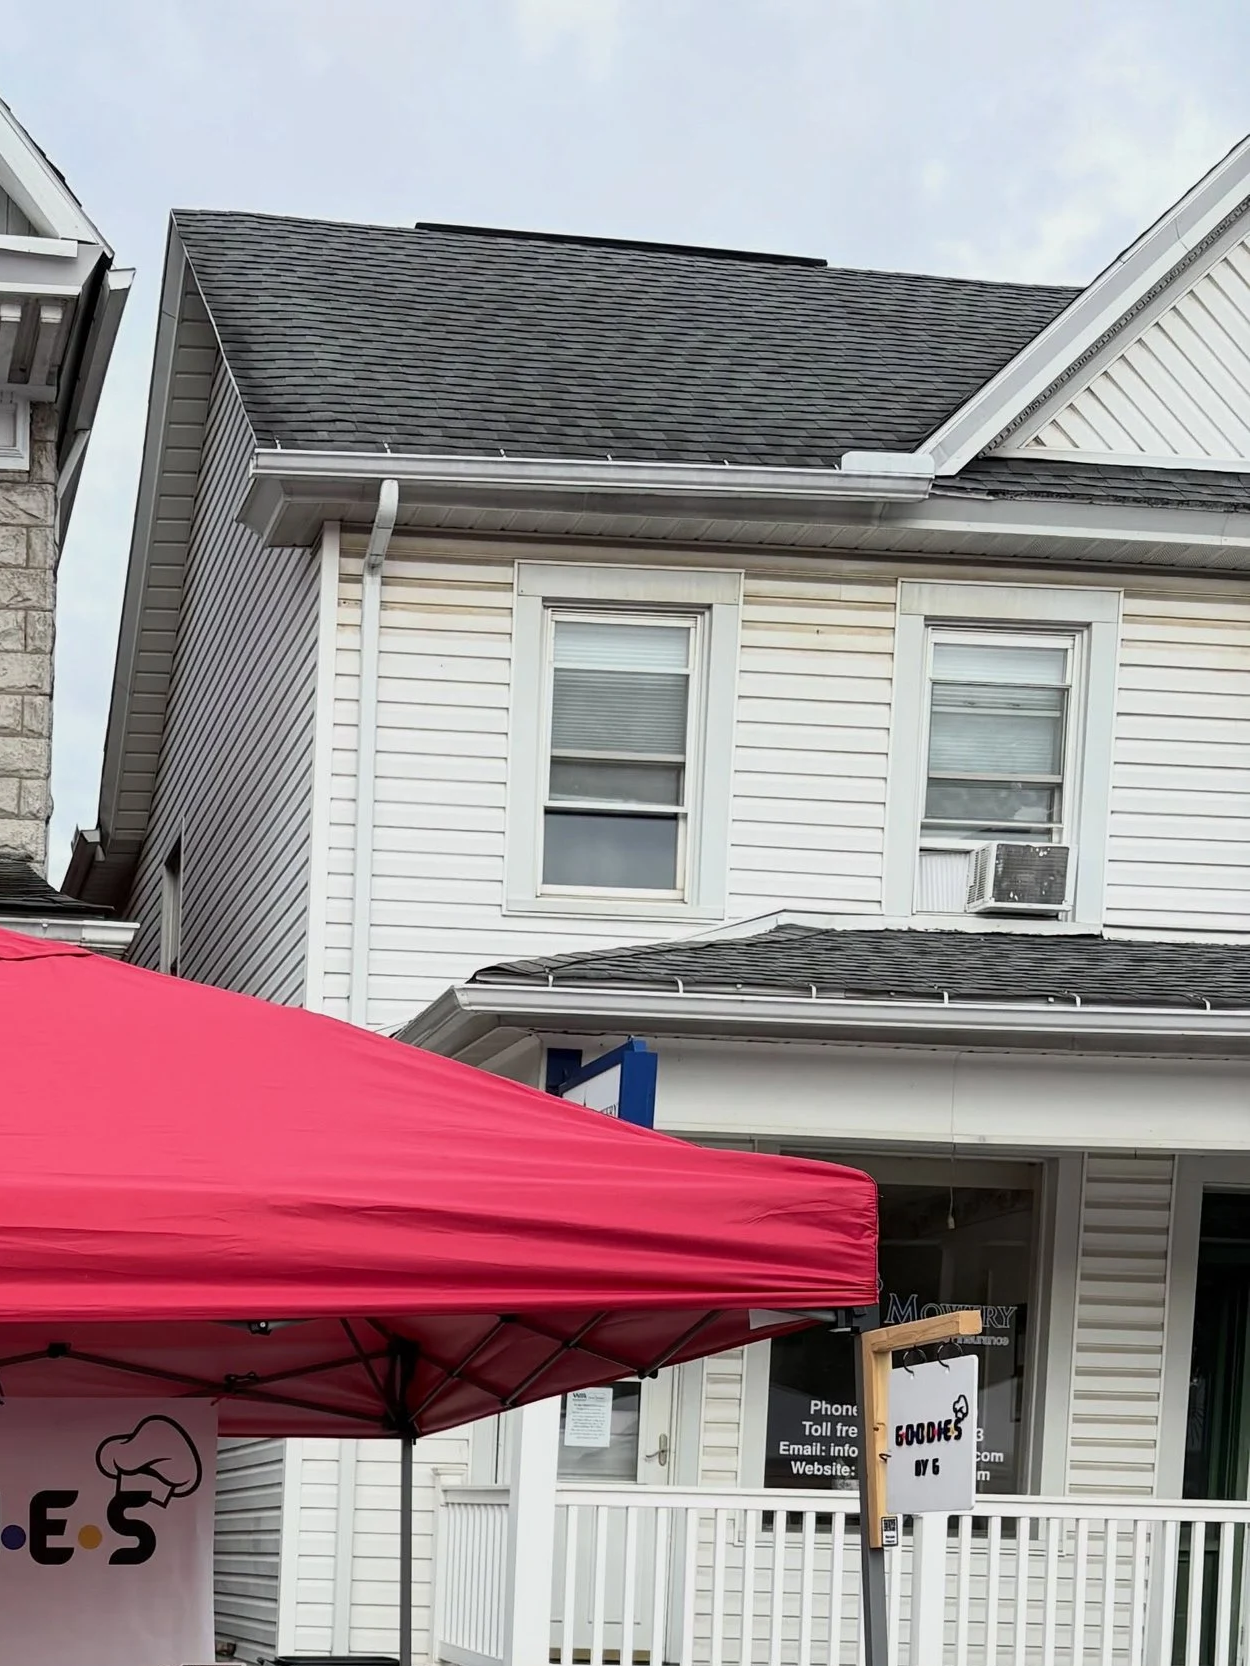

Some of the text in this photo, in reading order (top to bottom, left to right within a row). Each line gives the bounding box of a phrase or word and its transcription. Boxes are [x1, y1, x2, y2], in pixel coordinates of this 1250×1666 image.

[884, 1293, 1017, 1328] MORY
[802, 1421, 831, 1436] Toll
[895, 1418, 963, 1447] GOODIES
[779, 1441, 826, 1456] Email:
[791, 1461, 855, 1476] Website:
[914, 1457, 940, 1476] BY G
